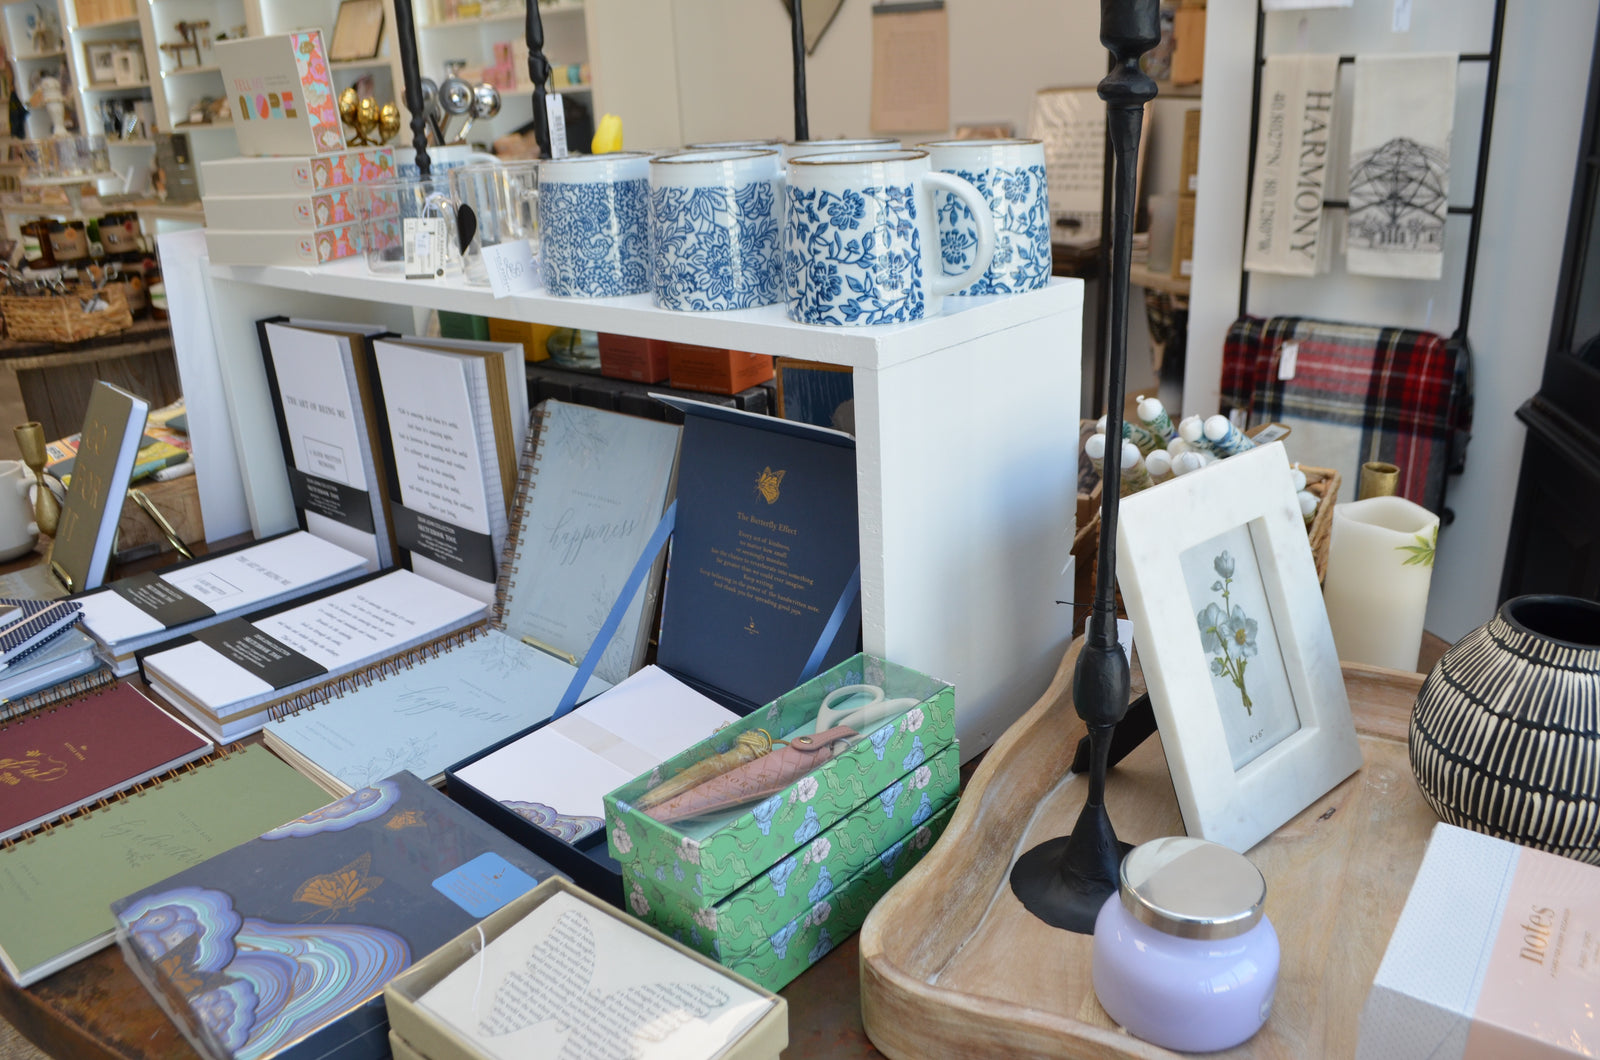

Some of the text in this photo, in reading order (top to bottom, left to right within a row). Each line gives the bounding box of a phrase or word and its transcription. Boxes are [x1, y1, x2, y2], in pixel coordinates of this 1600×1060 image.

[239, 92, 298, 121] MORE
[1289, 91, 1332, 259] HARMONY
[86, 419, 107, 456] GO
[74, 463, 101, 509] FOR
[61, 507, 79, 541] IT
[542, 506, 640, 566] happiness
[736, 511, 796, 535] The Butterfly Effect
[1520, 904, 1555, 965] notes
